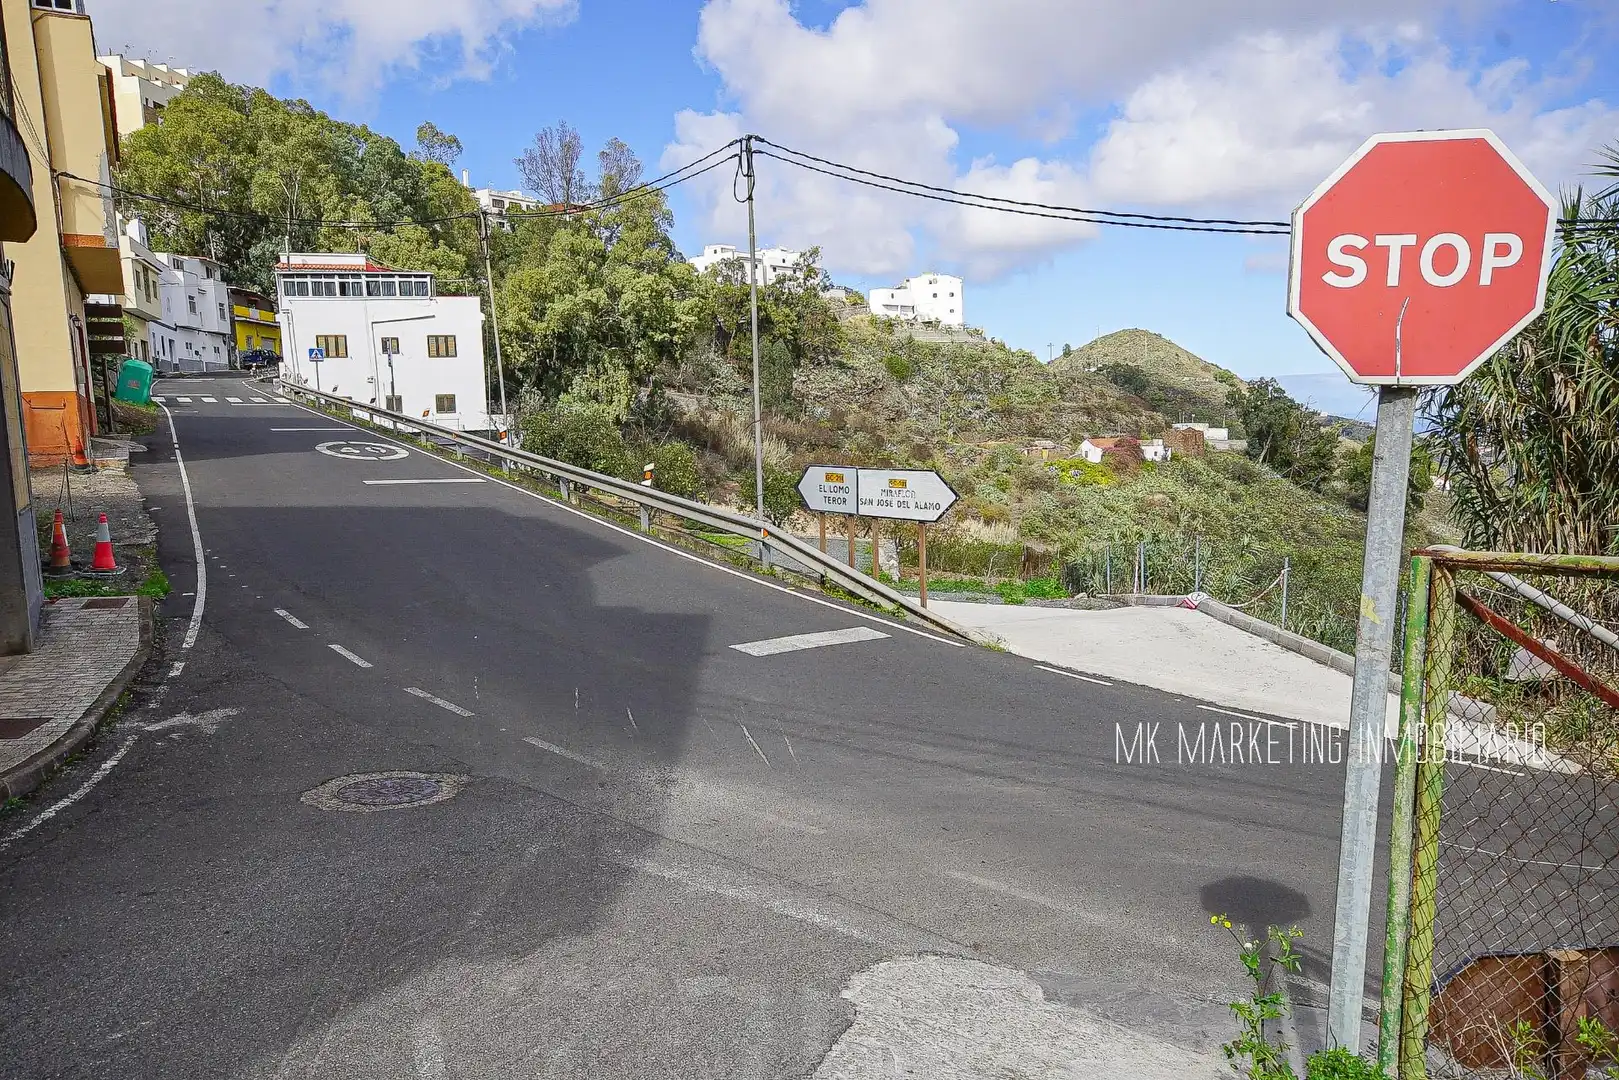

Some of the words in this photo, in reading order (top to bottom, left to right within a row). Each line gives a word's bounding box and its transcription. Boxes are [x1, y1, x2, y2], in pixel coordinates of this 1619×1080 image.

[1321, 232, 1524, 288] STOP
[818, 485, 828, 493] EL
[829, 485, 850, 494] LOMO
[880, 488, 916, 498] MIRAFLOR
[823, 496, 847, 506] TEROR
[859, 497, 874, 506] SAN
[897, 500, 910, 509] DEL
[915, 501, 941, 511] ALAMO
